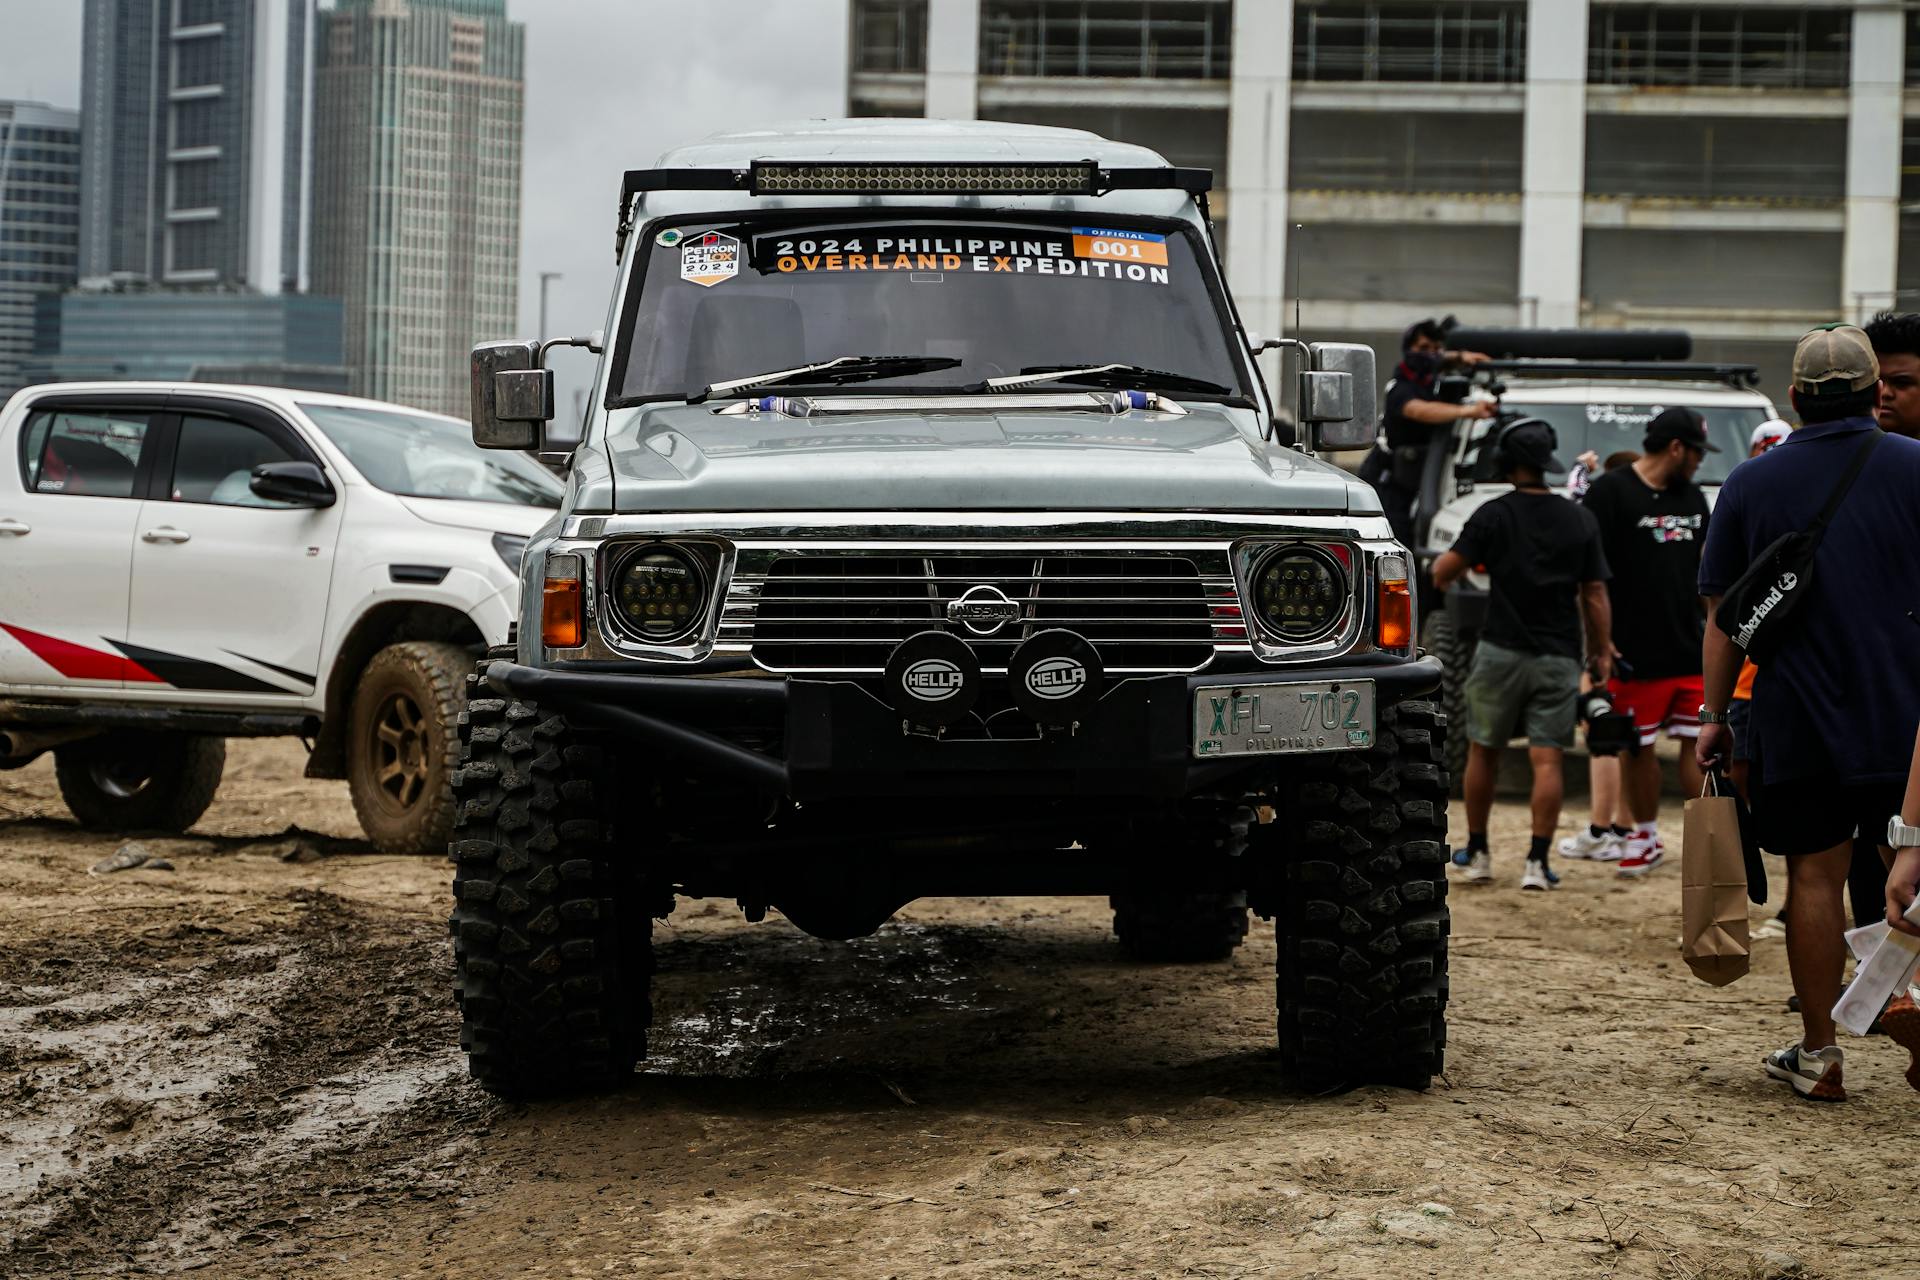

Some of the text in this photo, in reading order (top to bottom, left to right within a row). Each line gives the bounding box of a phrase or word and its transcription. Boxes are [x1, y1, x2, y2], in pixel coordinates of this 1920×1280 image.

[1091, 229, 1145, 240] OFFICIAL
[684, 245, 737, 256] PETRON
[776, 238, 1064, 257] 2024 PHILIPPINE
[1091, 240, 1142, 259] 001
[685, 253, 733, 264] PHLOX
[685, 262, 734, 273] 2024
[776, 253, 1170, 285] OVERLAND EXPEDITION
[952, 603, 1016, 618] NISSAN
[1731, 586, 1784, 650] Timberland
[908, 672, 964, 687] HELLA
[1030, 667, 1086, 687] HELLA
[1209, 689, 1362, 736] XFL 702
[1245, 736, 1326, 752] PILIPINAS
